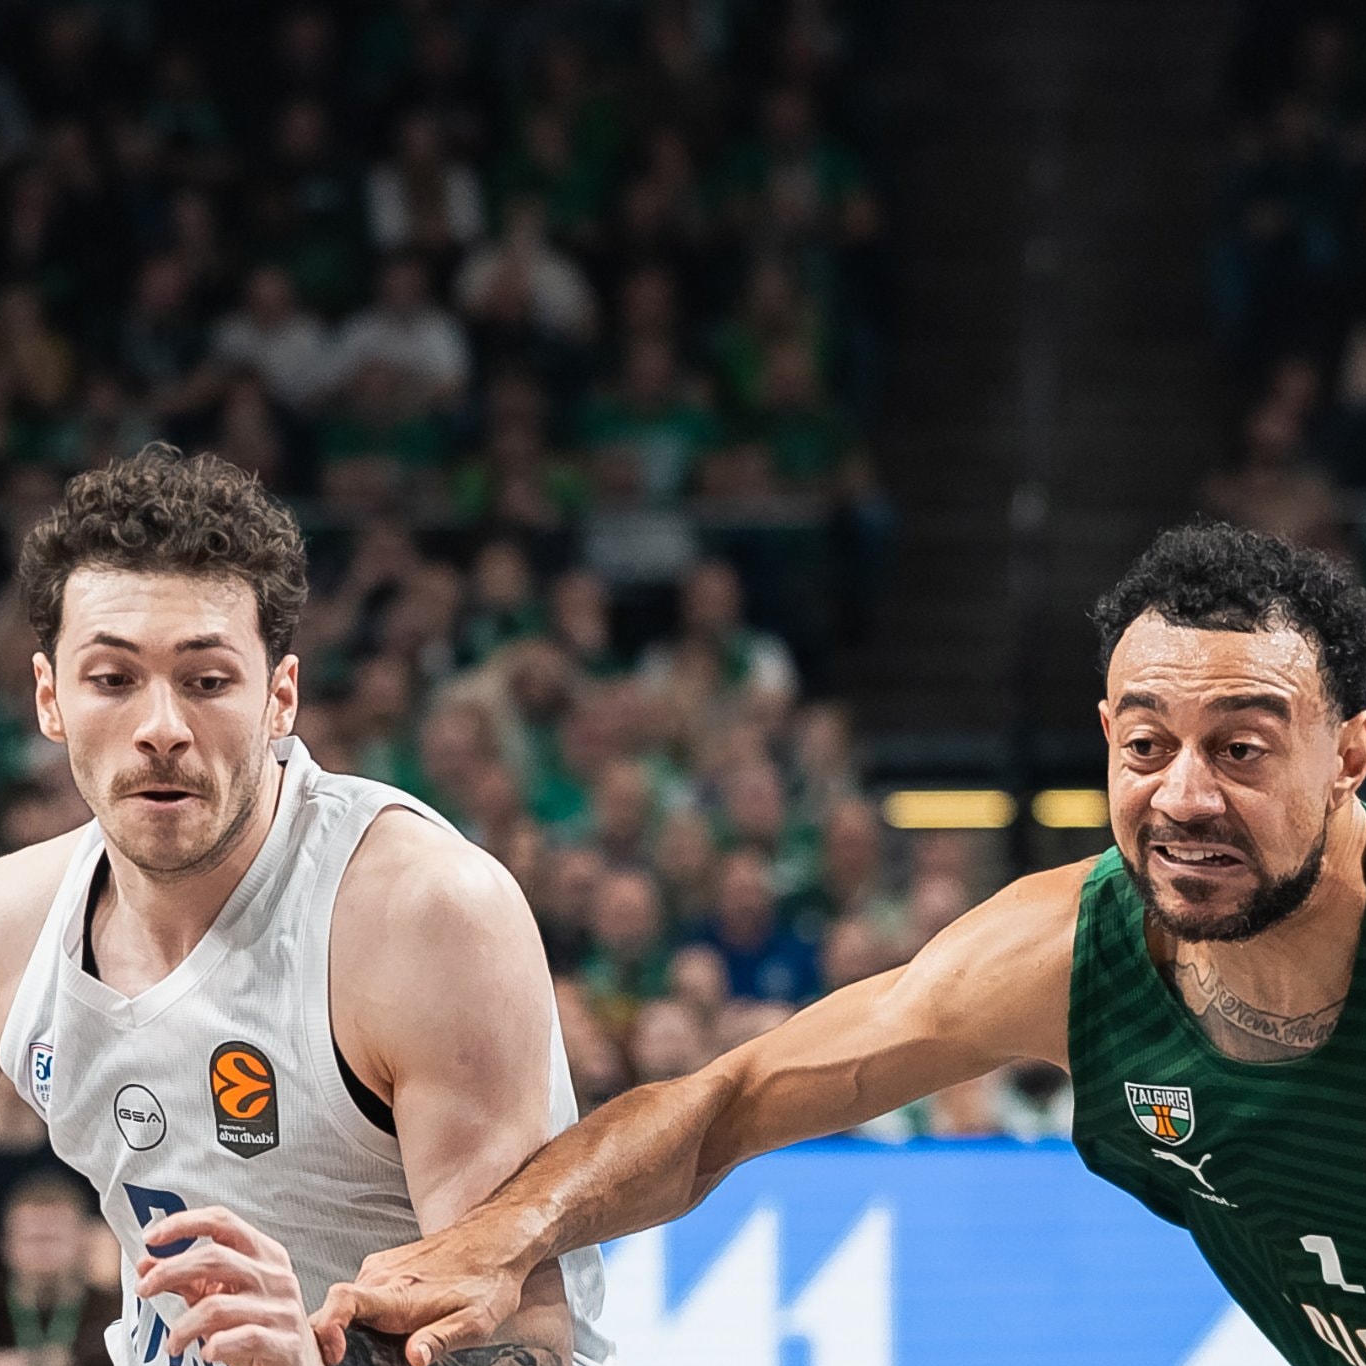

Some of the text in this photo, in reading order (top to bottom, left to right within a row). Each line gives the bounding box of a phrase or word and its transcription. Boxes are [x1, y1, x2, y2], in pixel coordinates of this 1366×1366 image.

[118, 1108, 162, 1124] GSA
[219, 1130, 275, 1144] abu dhabi
[1299, 1234, 1366, 1294] 1
